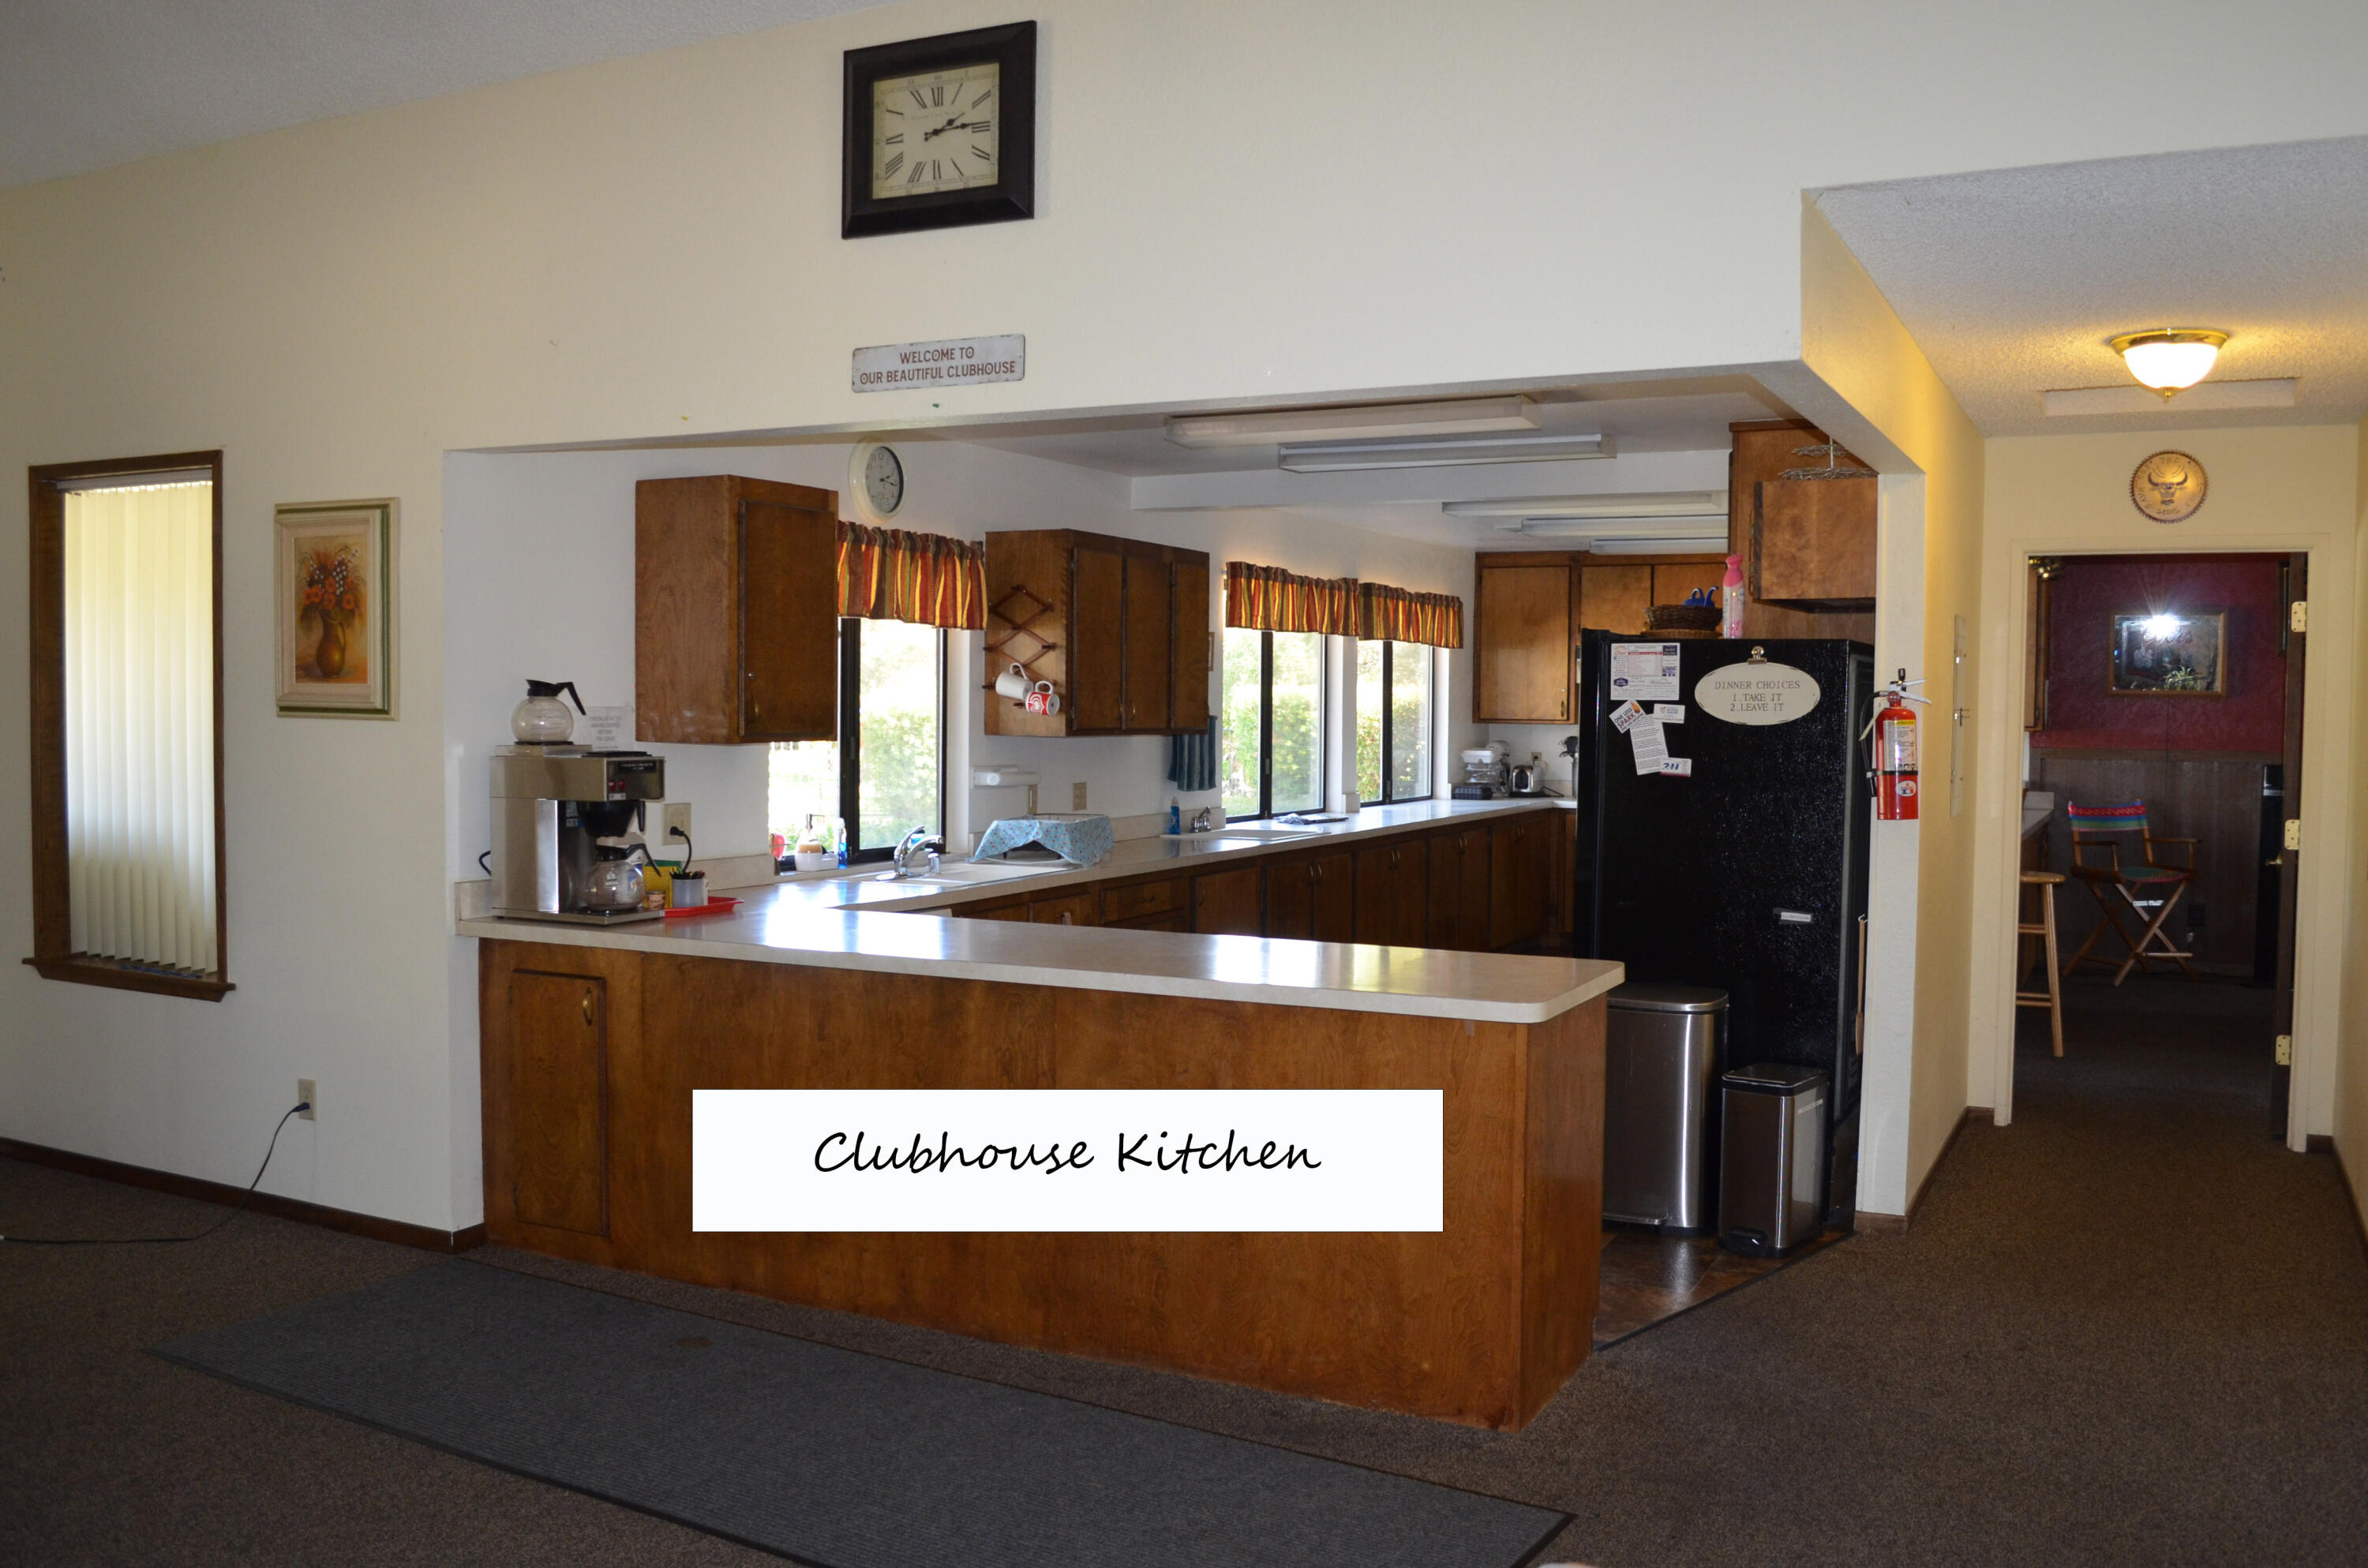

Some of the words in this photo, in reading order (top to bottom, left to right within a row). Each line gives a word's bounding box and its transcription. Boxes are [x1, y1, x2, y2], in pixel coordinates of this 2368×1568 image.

[899, 347, 956, 365] WELCOME
[958, 346, 975, 359] TO
[860, 372, 883, 385] OUR
[886, 366, 944, 384] BEAUTIFUL
[946, 361, 1017, 378] CLUBHOUSE
[1714, 681, 1752, 690] DINNER
[1755, 680, 1800, 690] CHOICES
[1770, 693, 1783, 702] IT
[1773, 702, 1785, 712] IT
[1617, 713, 1635, 728] SPARK
